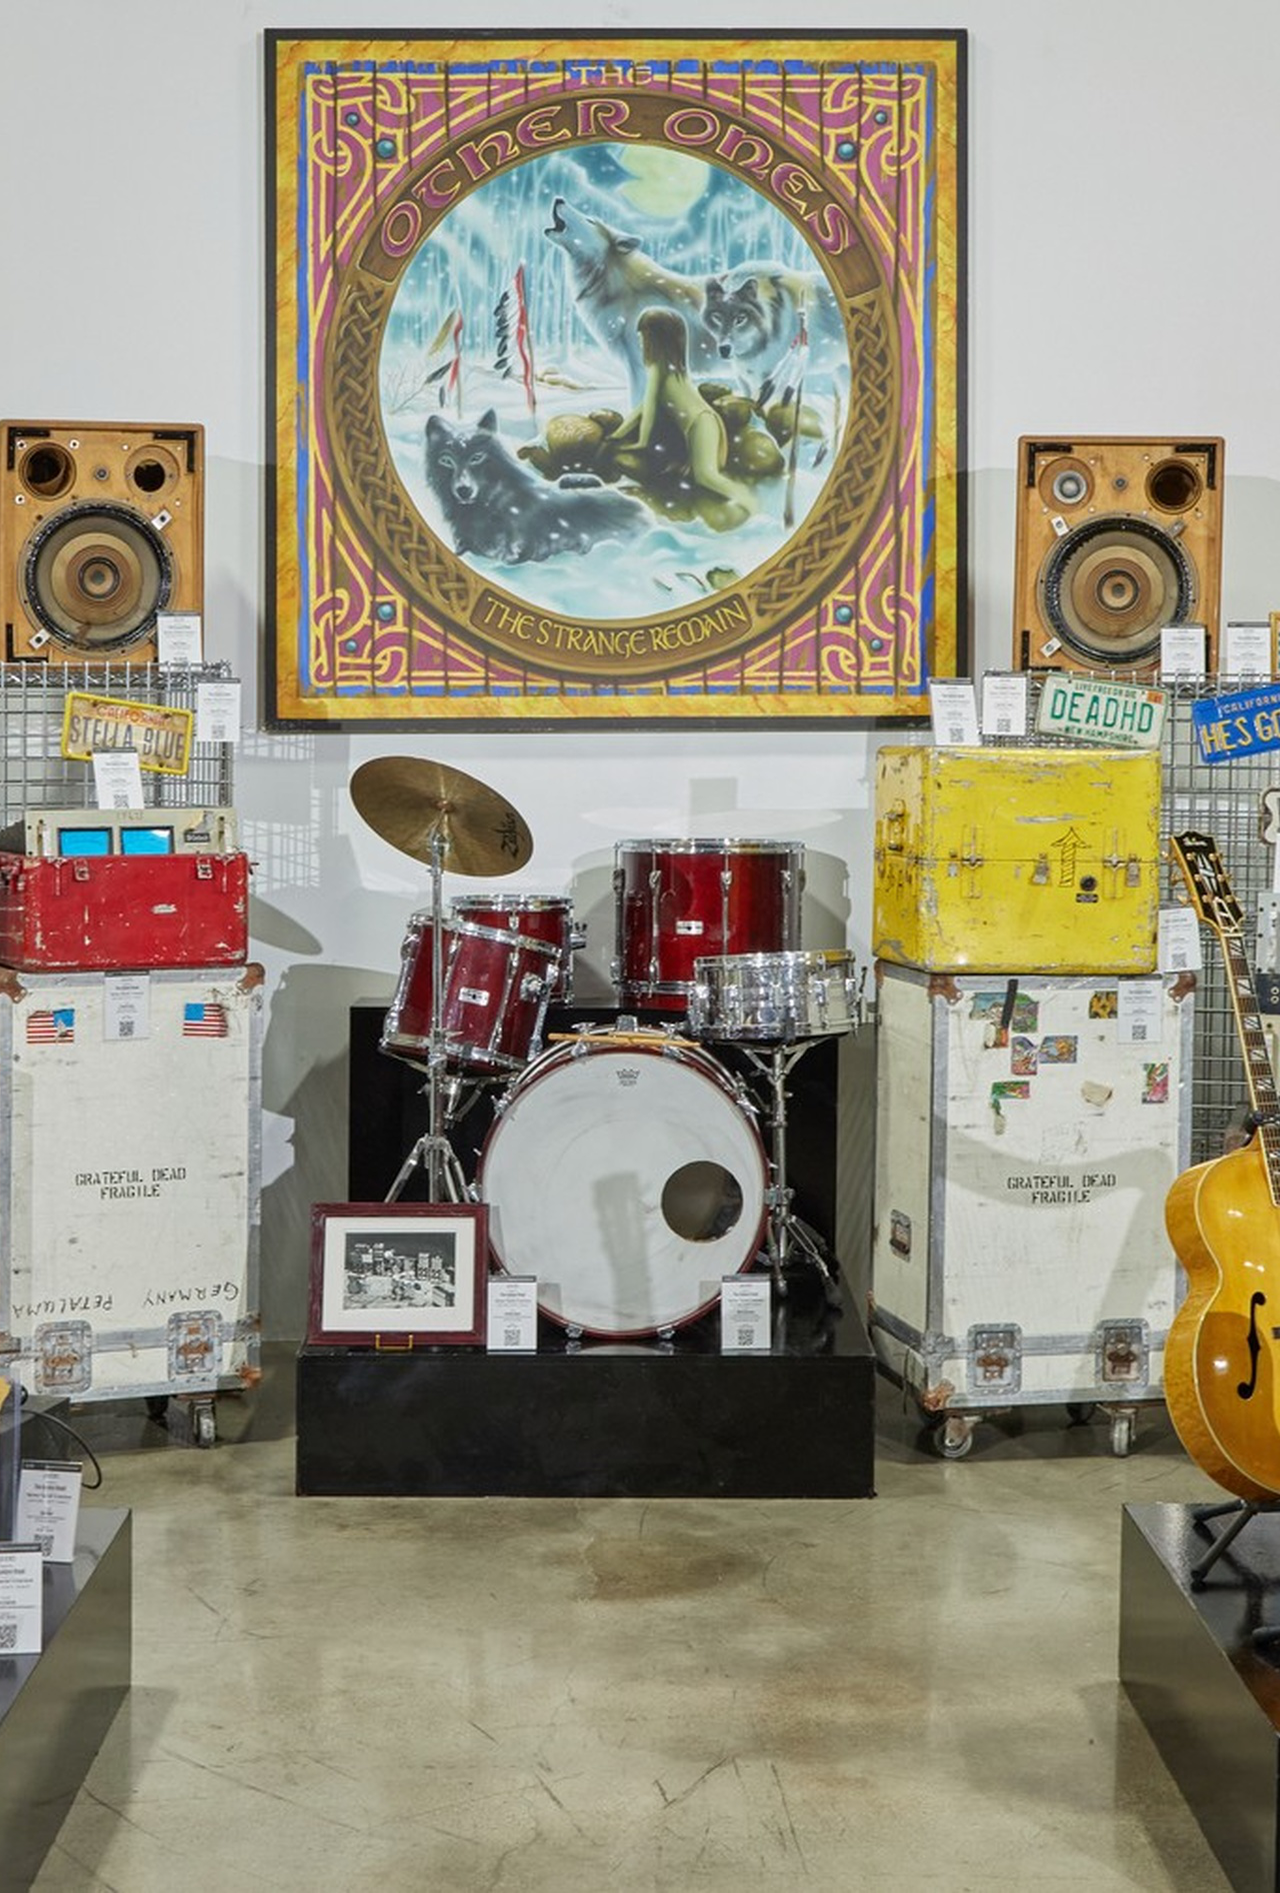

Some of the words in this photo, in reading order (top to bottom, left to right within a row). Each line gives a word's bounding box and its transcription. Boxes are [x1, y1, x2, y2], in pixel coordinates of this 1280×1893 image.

[570, 66, 653, 87] THE
[665, 108, 853, 257] ONES
[482, 596, 532, 641] THE
[534, 616, 648, 656] STRANGE
[1050, 688, 1154, 734] DEADHD
[142, 727, 186, 761] BLUE
[1201, 716, 1253, 754] HES
[74, 1169, 144, 1186] GRATEFUL
[151, 1167, 187, 1182] DEAD
[1006, 1174, 1075, 1190] GRATEFUL
[1082, 1173, 1117, 1188] DEAD
[100, 1183, 161, 1200] FRAGILE
[1031, 1189, 1091, 1204] FRAGILE
[11, 1293, 114, 1319] PETALUMA
[143, 1281, 240, 1307] GERMANY
